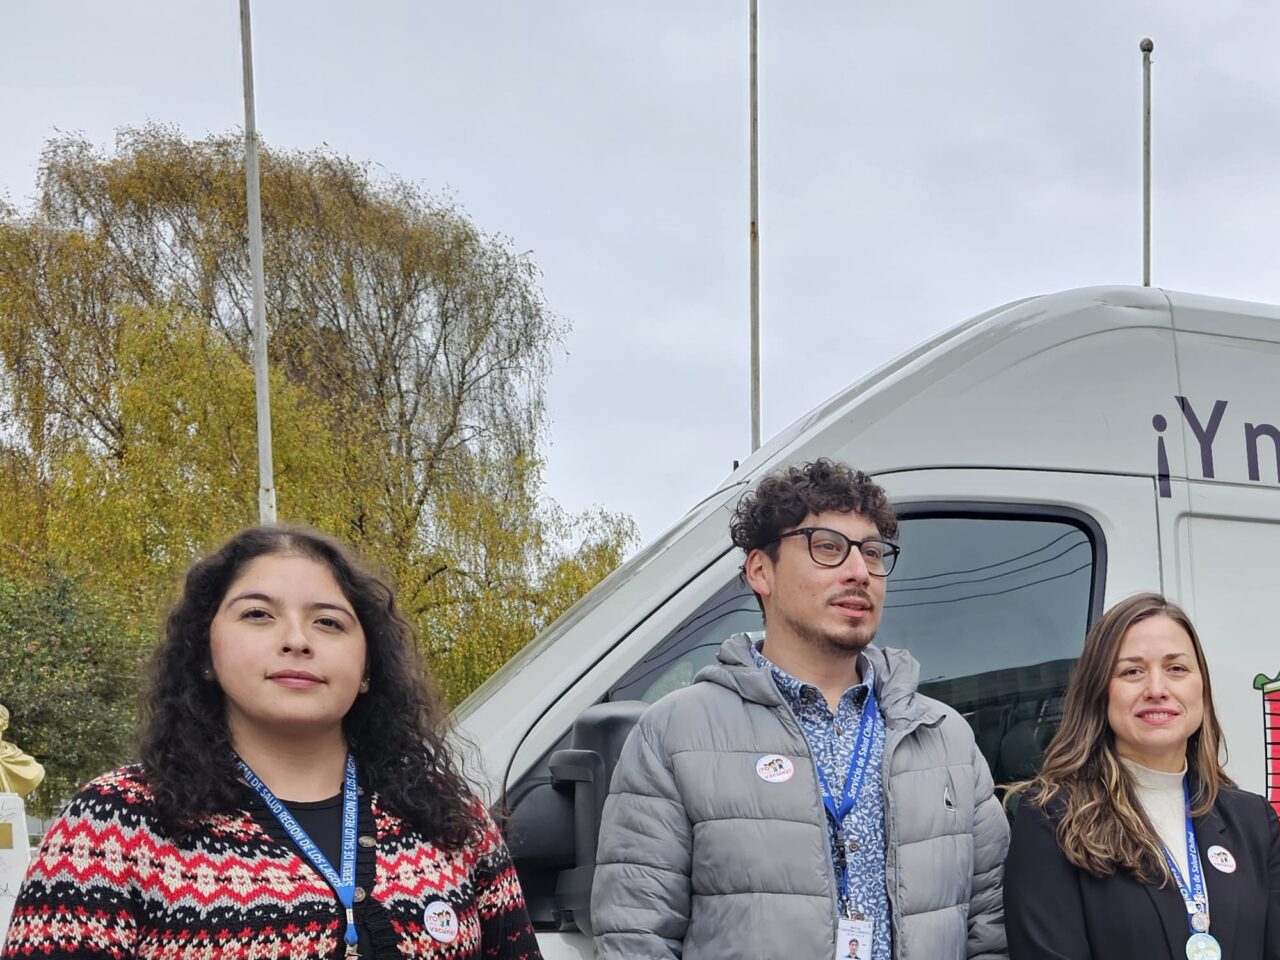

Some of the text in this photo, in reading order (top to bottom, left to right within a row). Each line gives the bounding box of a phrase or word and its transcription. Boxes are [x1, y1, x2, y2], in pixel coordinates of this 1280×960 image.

[1152, 395, 1228, 499] ¡Y
[858, 736, 870, 757] Salud
[857, 755, 867, 770] de
[847, 767, 864, 800] Servicio
[345, 789, 357, 801] DE
[344, 799, 357, 829] REGION
[250, 777, 264, 792] DE
[260, 788, 282, 814] SALUD
[277, 811, 306, 841] REGION
[299, 839, 314, 852] DE
[307, 849, 326, 865] LOS
[318, 863, 345, 888] LAGOS
[344, 828, 356, 850] SALUD
[343, 850, 355, 860] DE
[1190, 853, 1200, 874] Salud
[342, 860, 355, 887] SEREMI
[1192, 873, 1201, 885] de
